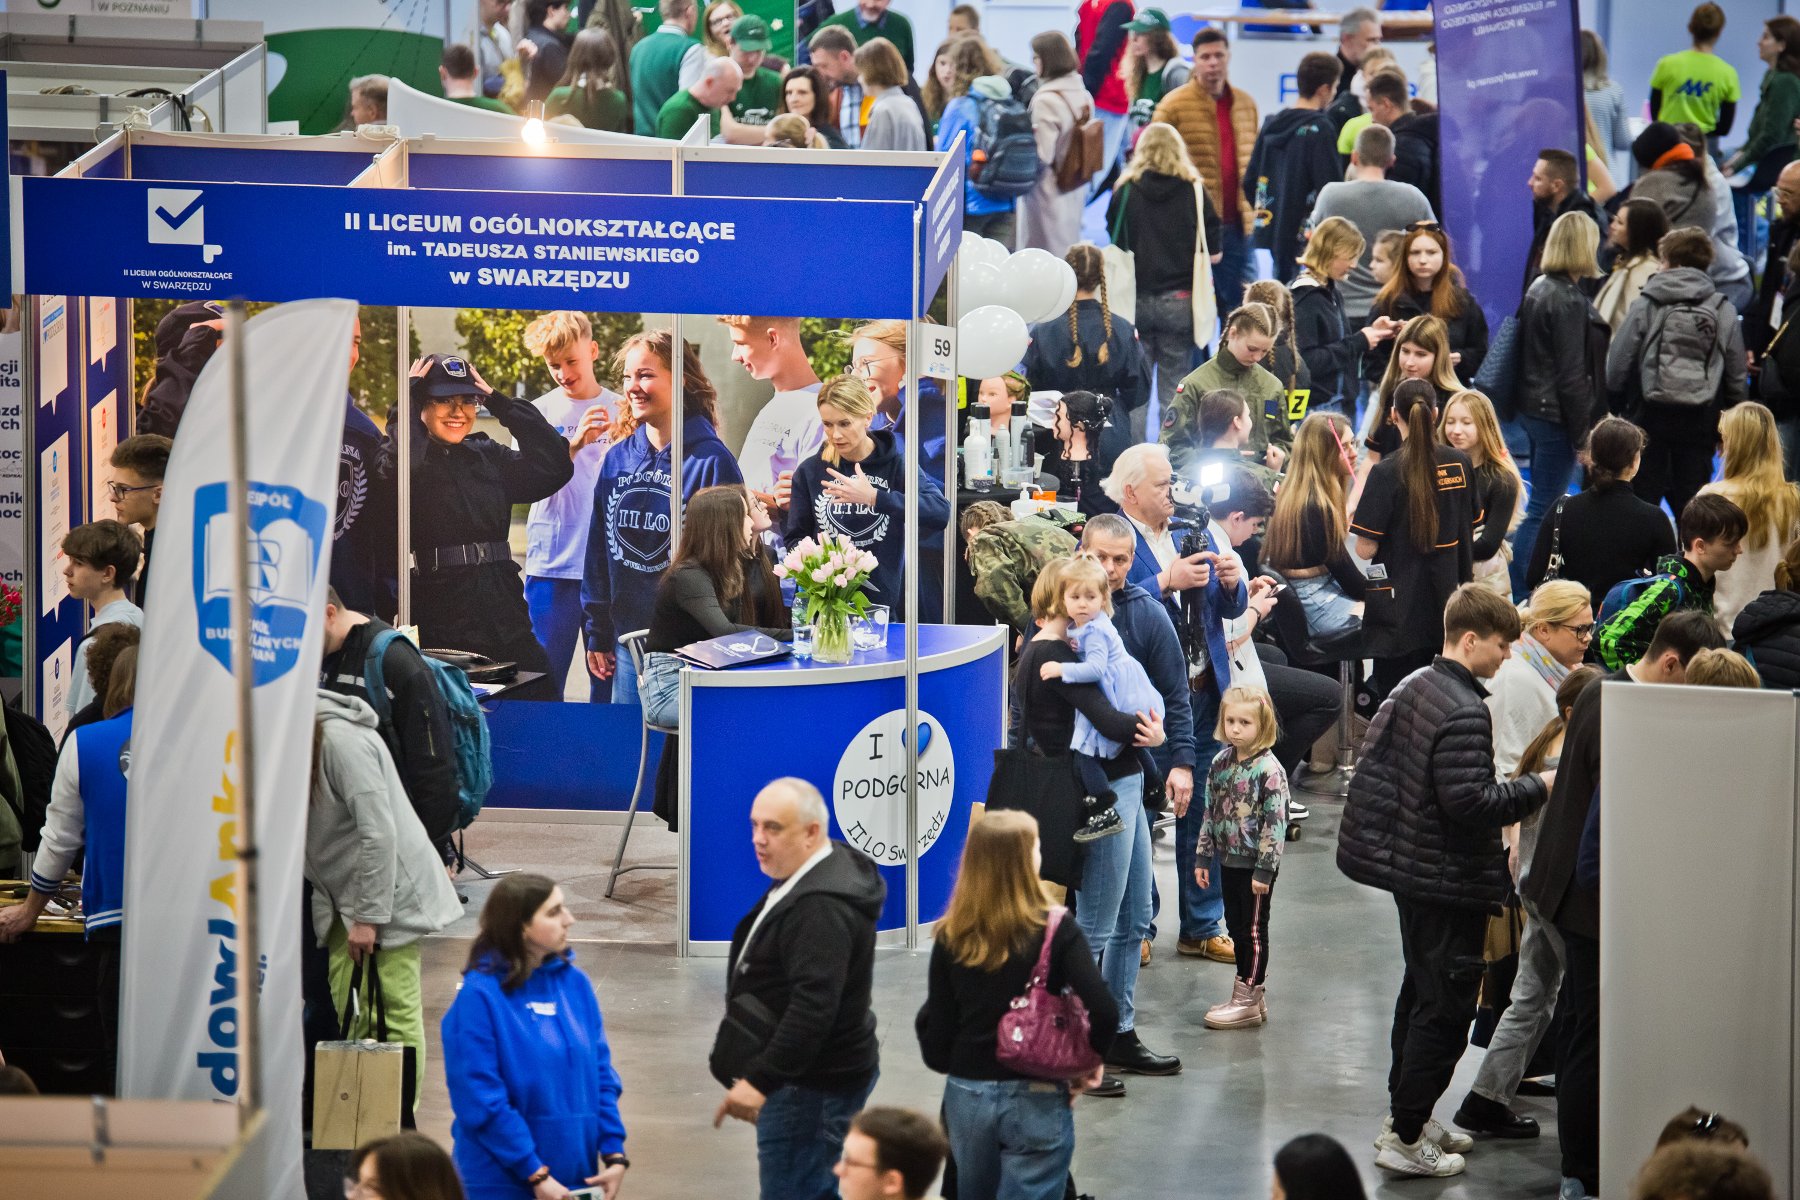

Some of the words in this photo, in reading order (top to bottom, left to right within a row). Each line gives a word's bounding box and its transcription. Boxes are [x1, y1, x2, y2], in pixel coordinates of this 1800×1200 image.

[344, 212, 361, 230] II
[368, 213, 462, 233] LICEUM
[469, 213, 736, 244] OGÓLNOKSZTAŁCĄCE
[387, 241, 417, 256] im.
[422, 242, 528, 259] TADEUSZA
[533, 245, 700, 264] STANIEWSKIEGO
[142, 280, 151, 289] W
[153, 280, 212, 292] SWARZĘDZU
[158, 269, 233, 281] OGÓLNOKSZTAŁCĄCE
[449, 271, 470, 285] w
[477, 267, 630, 292] SWARZĘDZU
[934, 338, 951, 357] 59
[618, 509, 640, 530] II
[643, 512, 670, 533] LO
[869, 733, 884, 760] I
[863, 836, 886, 858] LO
